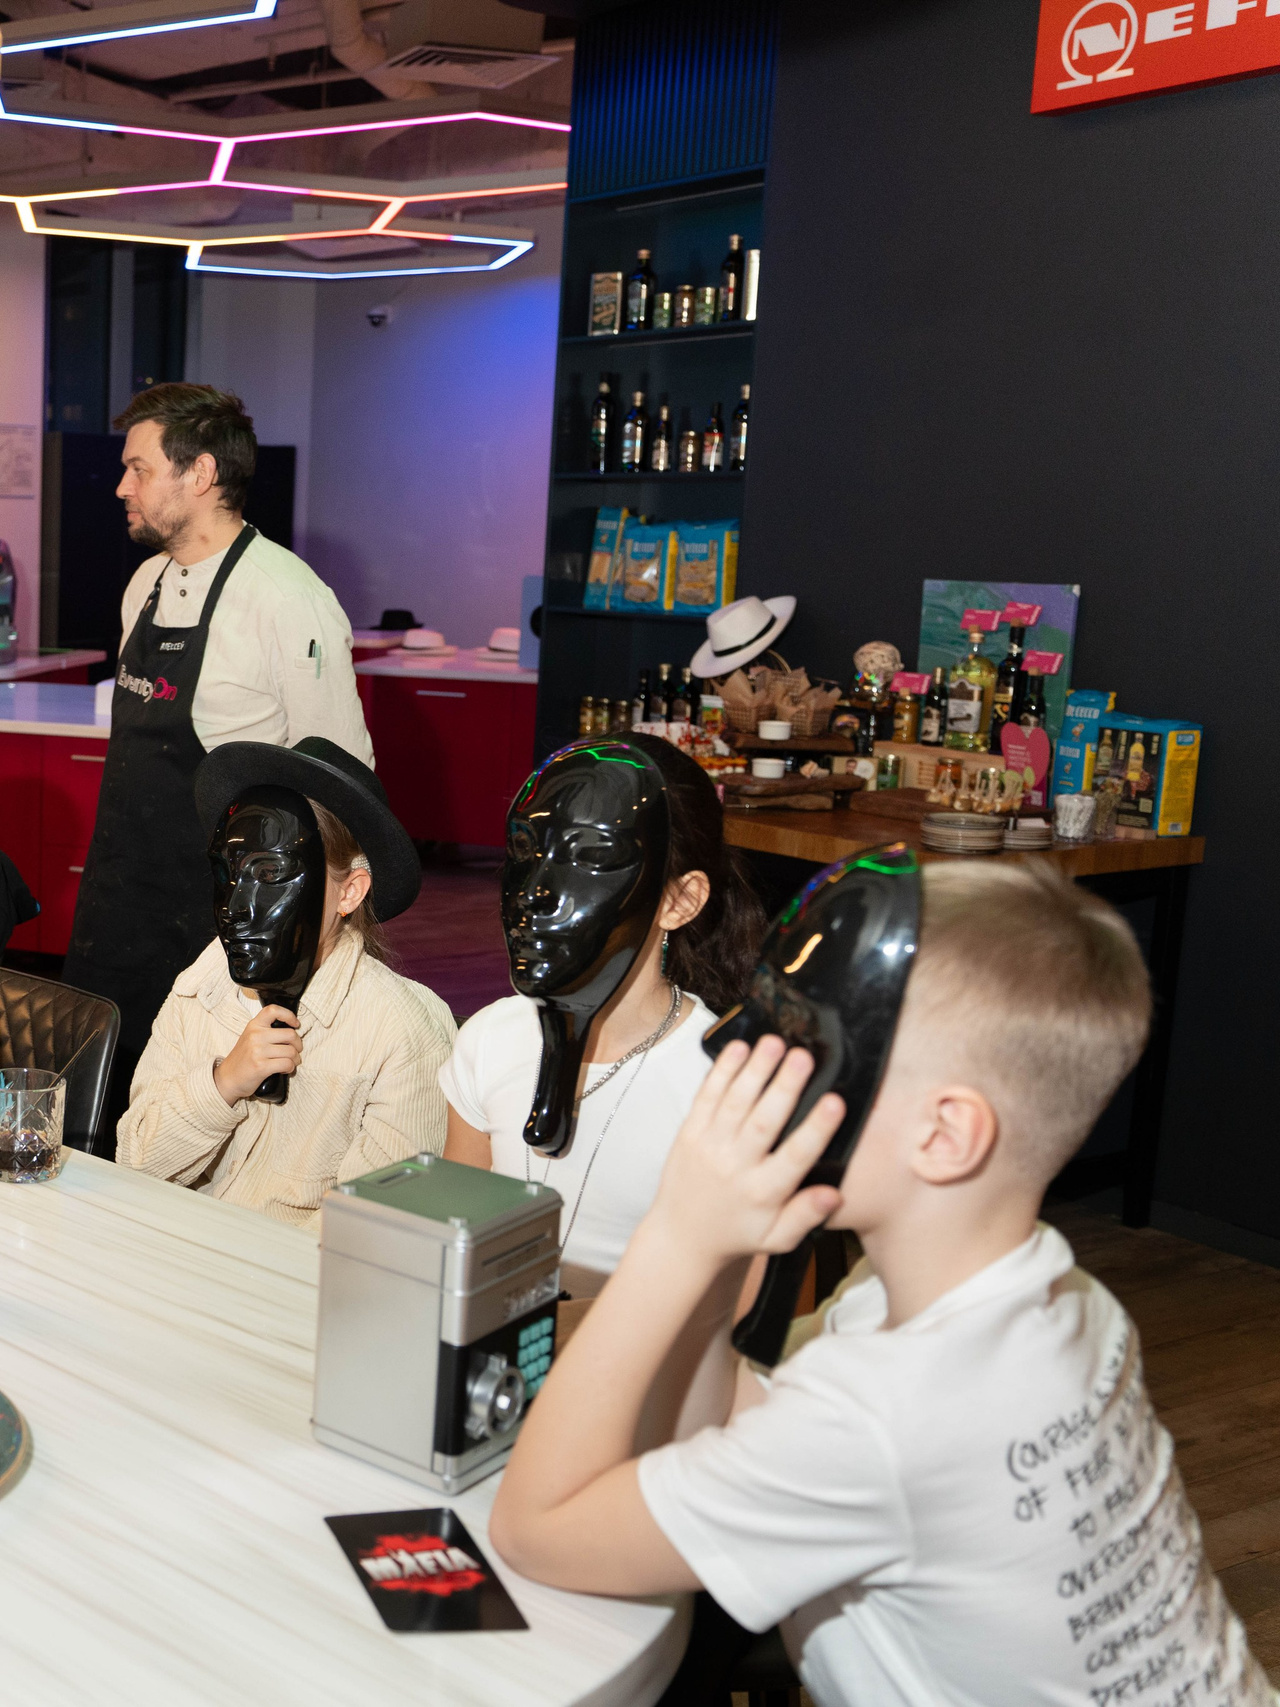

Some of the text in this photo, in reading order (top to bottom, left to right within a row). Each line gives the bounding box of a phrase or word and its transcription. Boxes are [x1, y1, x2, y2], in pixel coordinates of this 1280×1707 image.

[117, 663, 178, 703] EventyOn
[1014, 1484, 1047, 1523] OF
[359, 1546, 480, 1582] MAFIA
